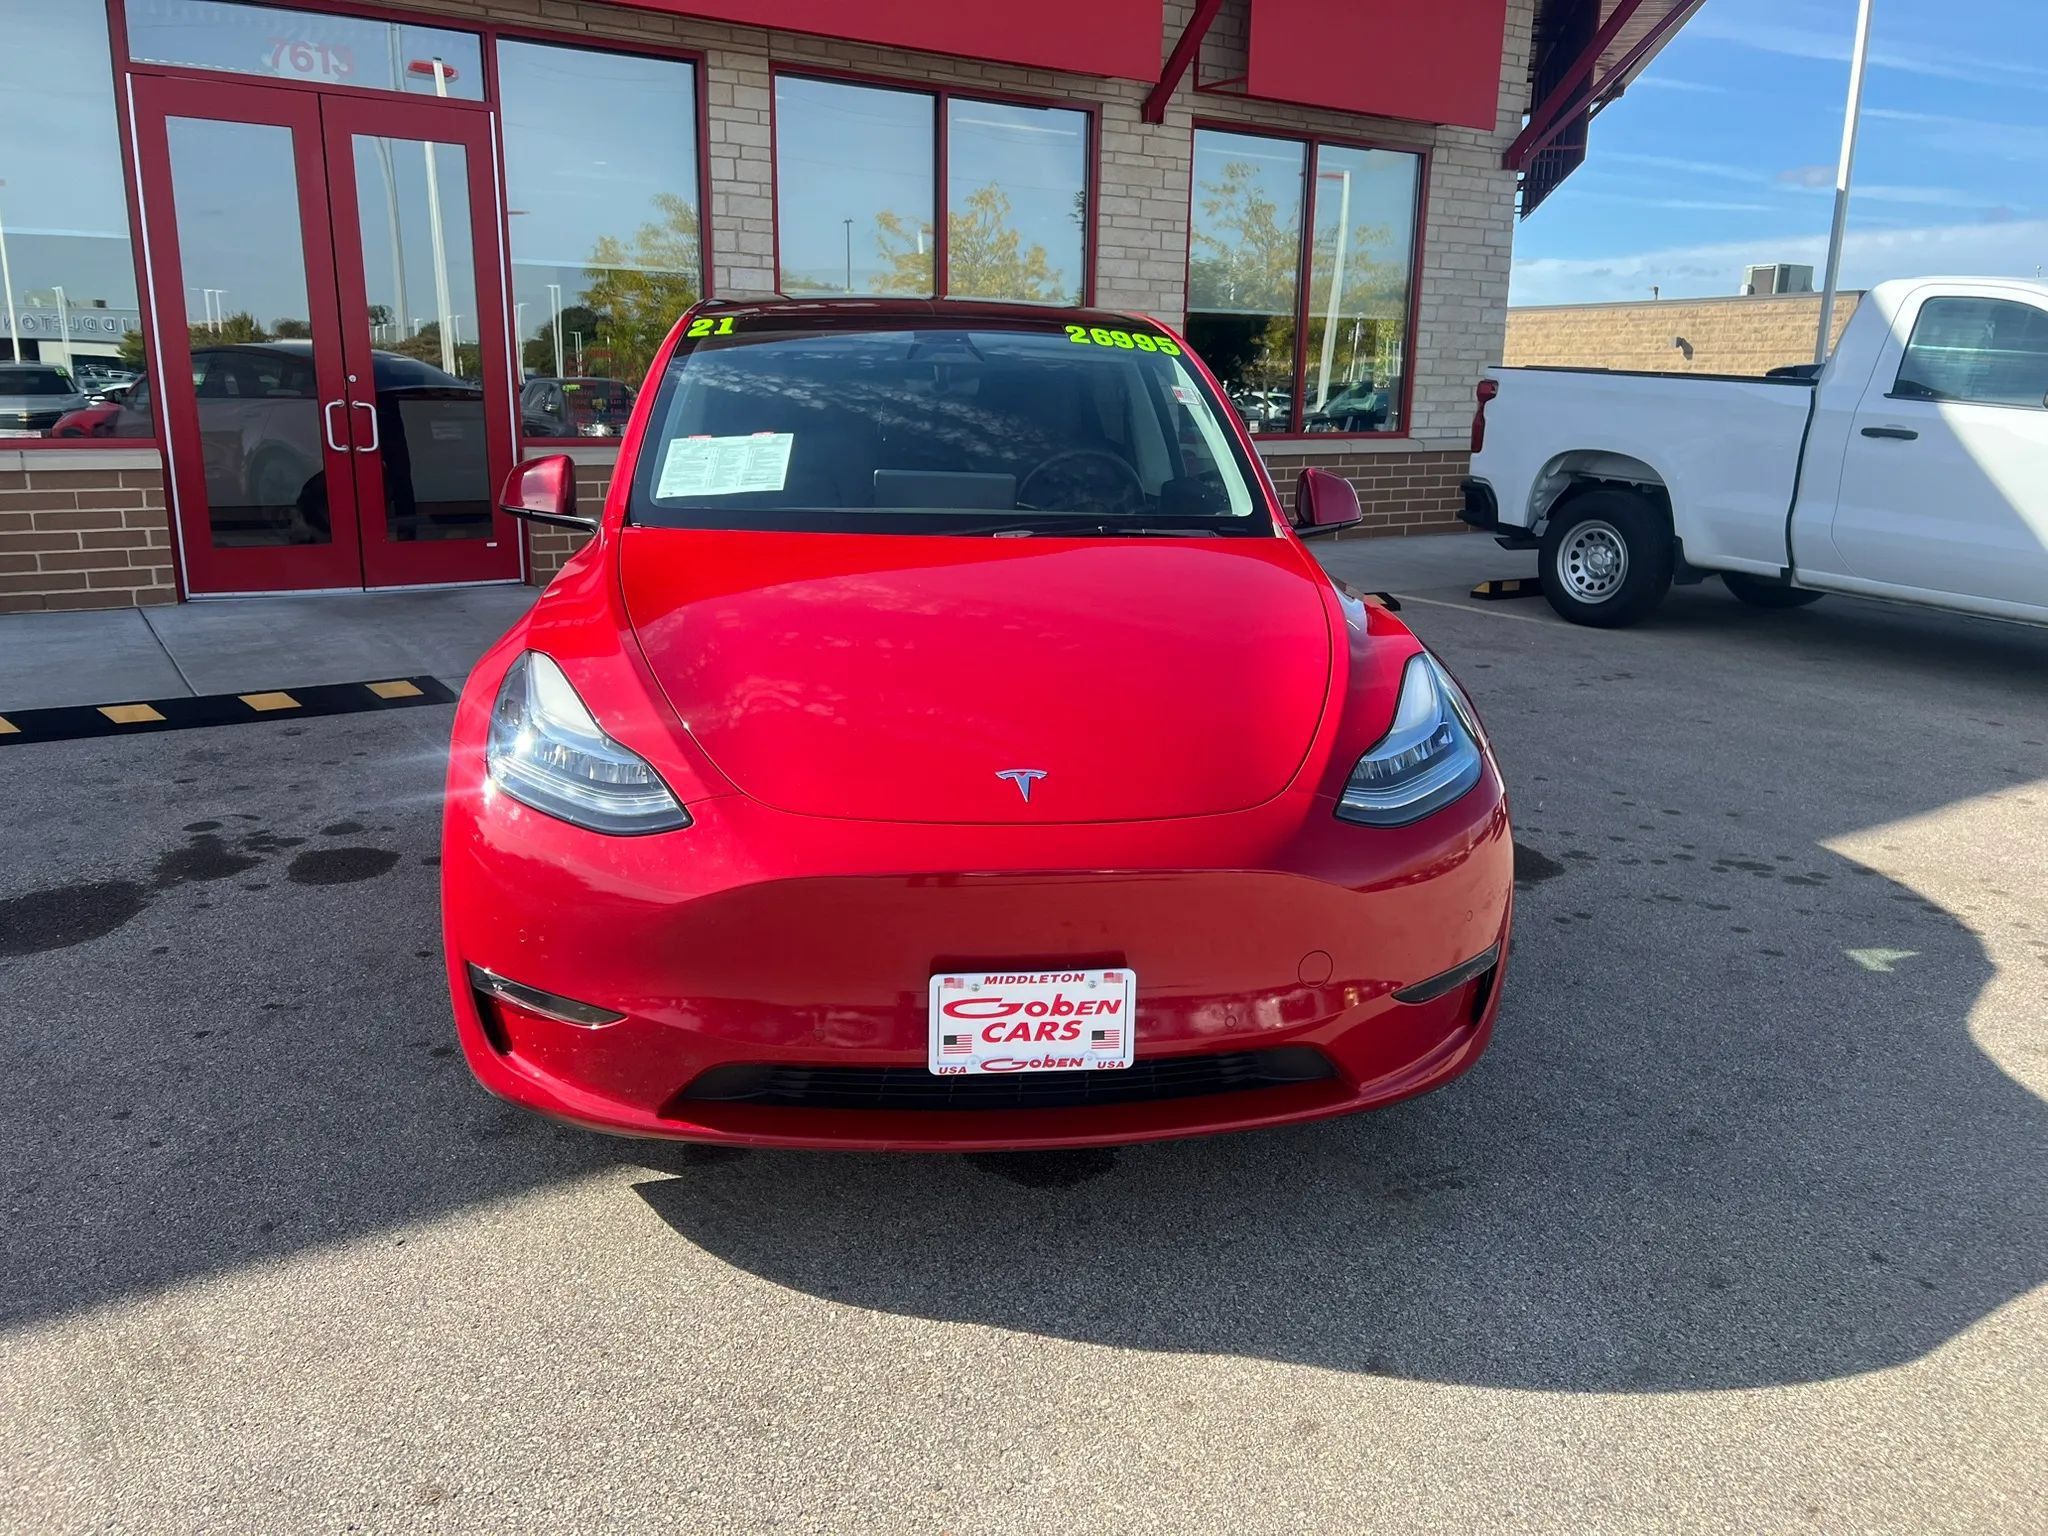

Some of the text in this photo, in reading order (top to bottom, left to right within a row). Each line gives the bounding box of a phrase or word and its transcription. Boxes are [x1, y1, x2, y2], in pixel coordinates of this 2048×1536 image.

[687, 317, 734, 337] 21
[1065, 325, 1181, 356] 26995
[984, 973, 1085, 985] MIDDLETON
[981, 1020, 1084, 1043] CARS
[938, 1066, 967, 1075] USA
[1097, 1061, 1125, 1069] USA
